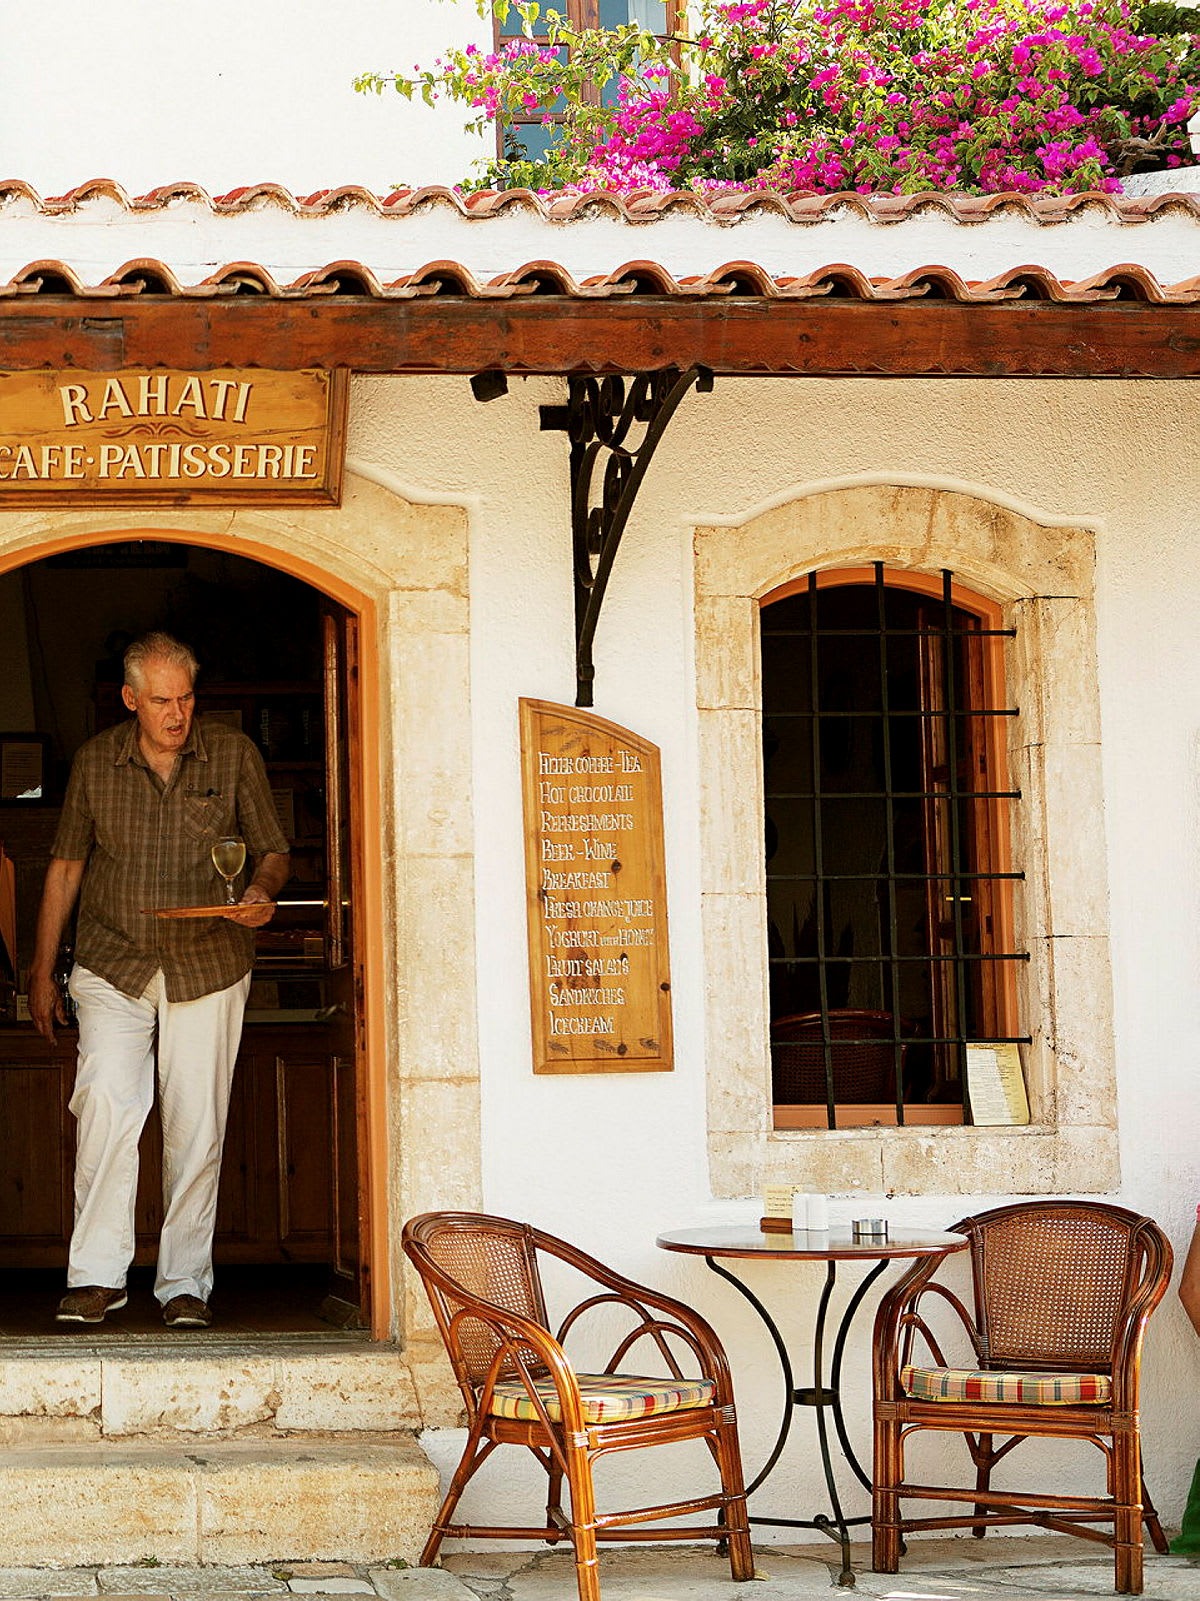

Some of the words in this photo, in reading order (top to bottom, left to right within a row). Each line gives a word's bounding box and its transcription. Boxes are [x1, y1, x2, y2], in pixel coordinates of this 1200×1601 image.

[59, 375, 253, 427] RAHATI
[538, 751, 574, 775] FILTER
[539, 782, 565, 804] HOT
[569, 784, 634, 803] CHOCOLATE
[540, 810, 634, 833] REFRESHMENTS
[542, 868, 611, 890] BREAKFAST
[543, 895, 582, 919] FRESH
[583, 900, 624, 917] ORANGE
[623, 900, 654, 923] JUICE
[545, 924, 600, 949] YOGHURT
[546, 954, 584, 977] FRUIT
[585, 957, 630, 976] SALADS
[549, 983, 625, 1006] SANDWICHES
